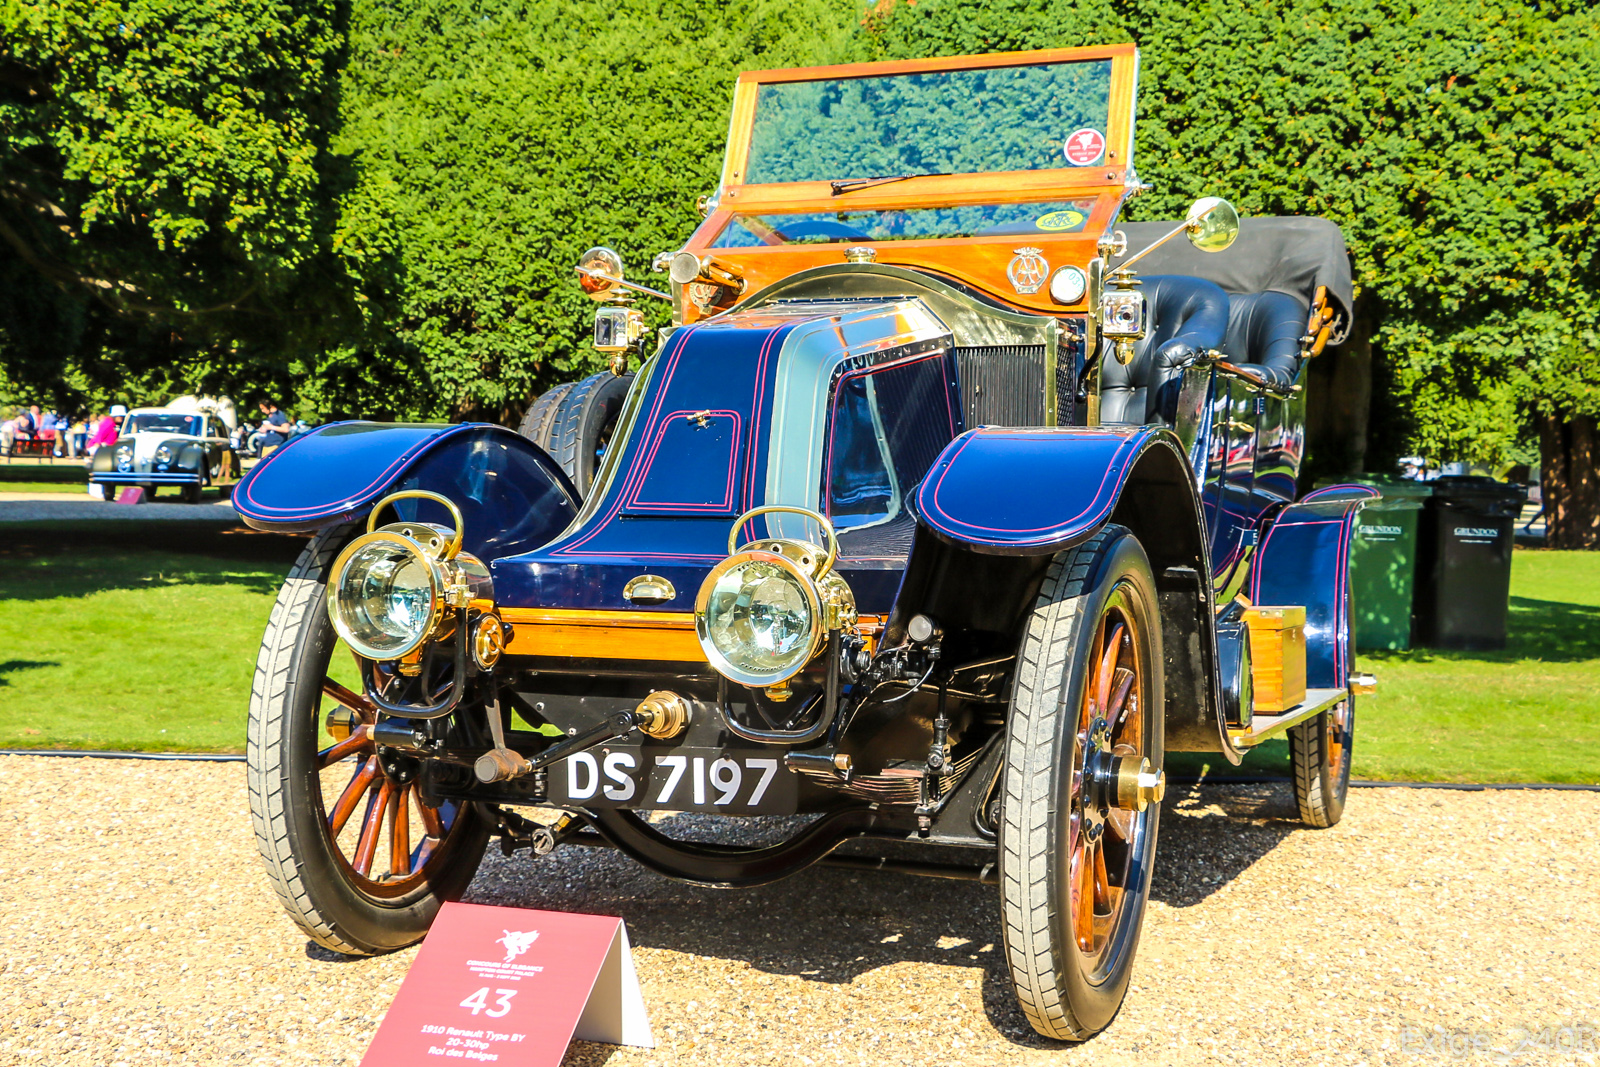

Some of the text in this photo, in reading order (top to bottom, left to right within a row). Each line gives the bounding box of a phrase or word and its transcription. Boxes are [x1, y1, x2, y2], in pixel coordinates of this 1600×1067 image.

[1358, 525, 1402, 533] GRUNDON
[1454, 527, 1498, 535] GRUNDON
[568, 751, 778, 806] DS 7197
[459, 987, 518, 1018] 43
[421, 1024, 526, 1042] 1910 Renault Type BY
[446, 1037, 490, 1050] 20-30hp
[428, 1046, 446, 1055] Roi
[446, 1048, 464, 1057] des
